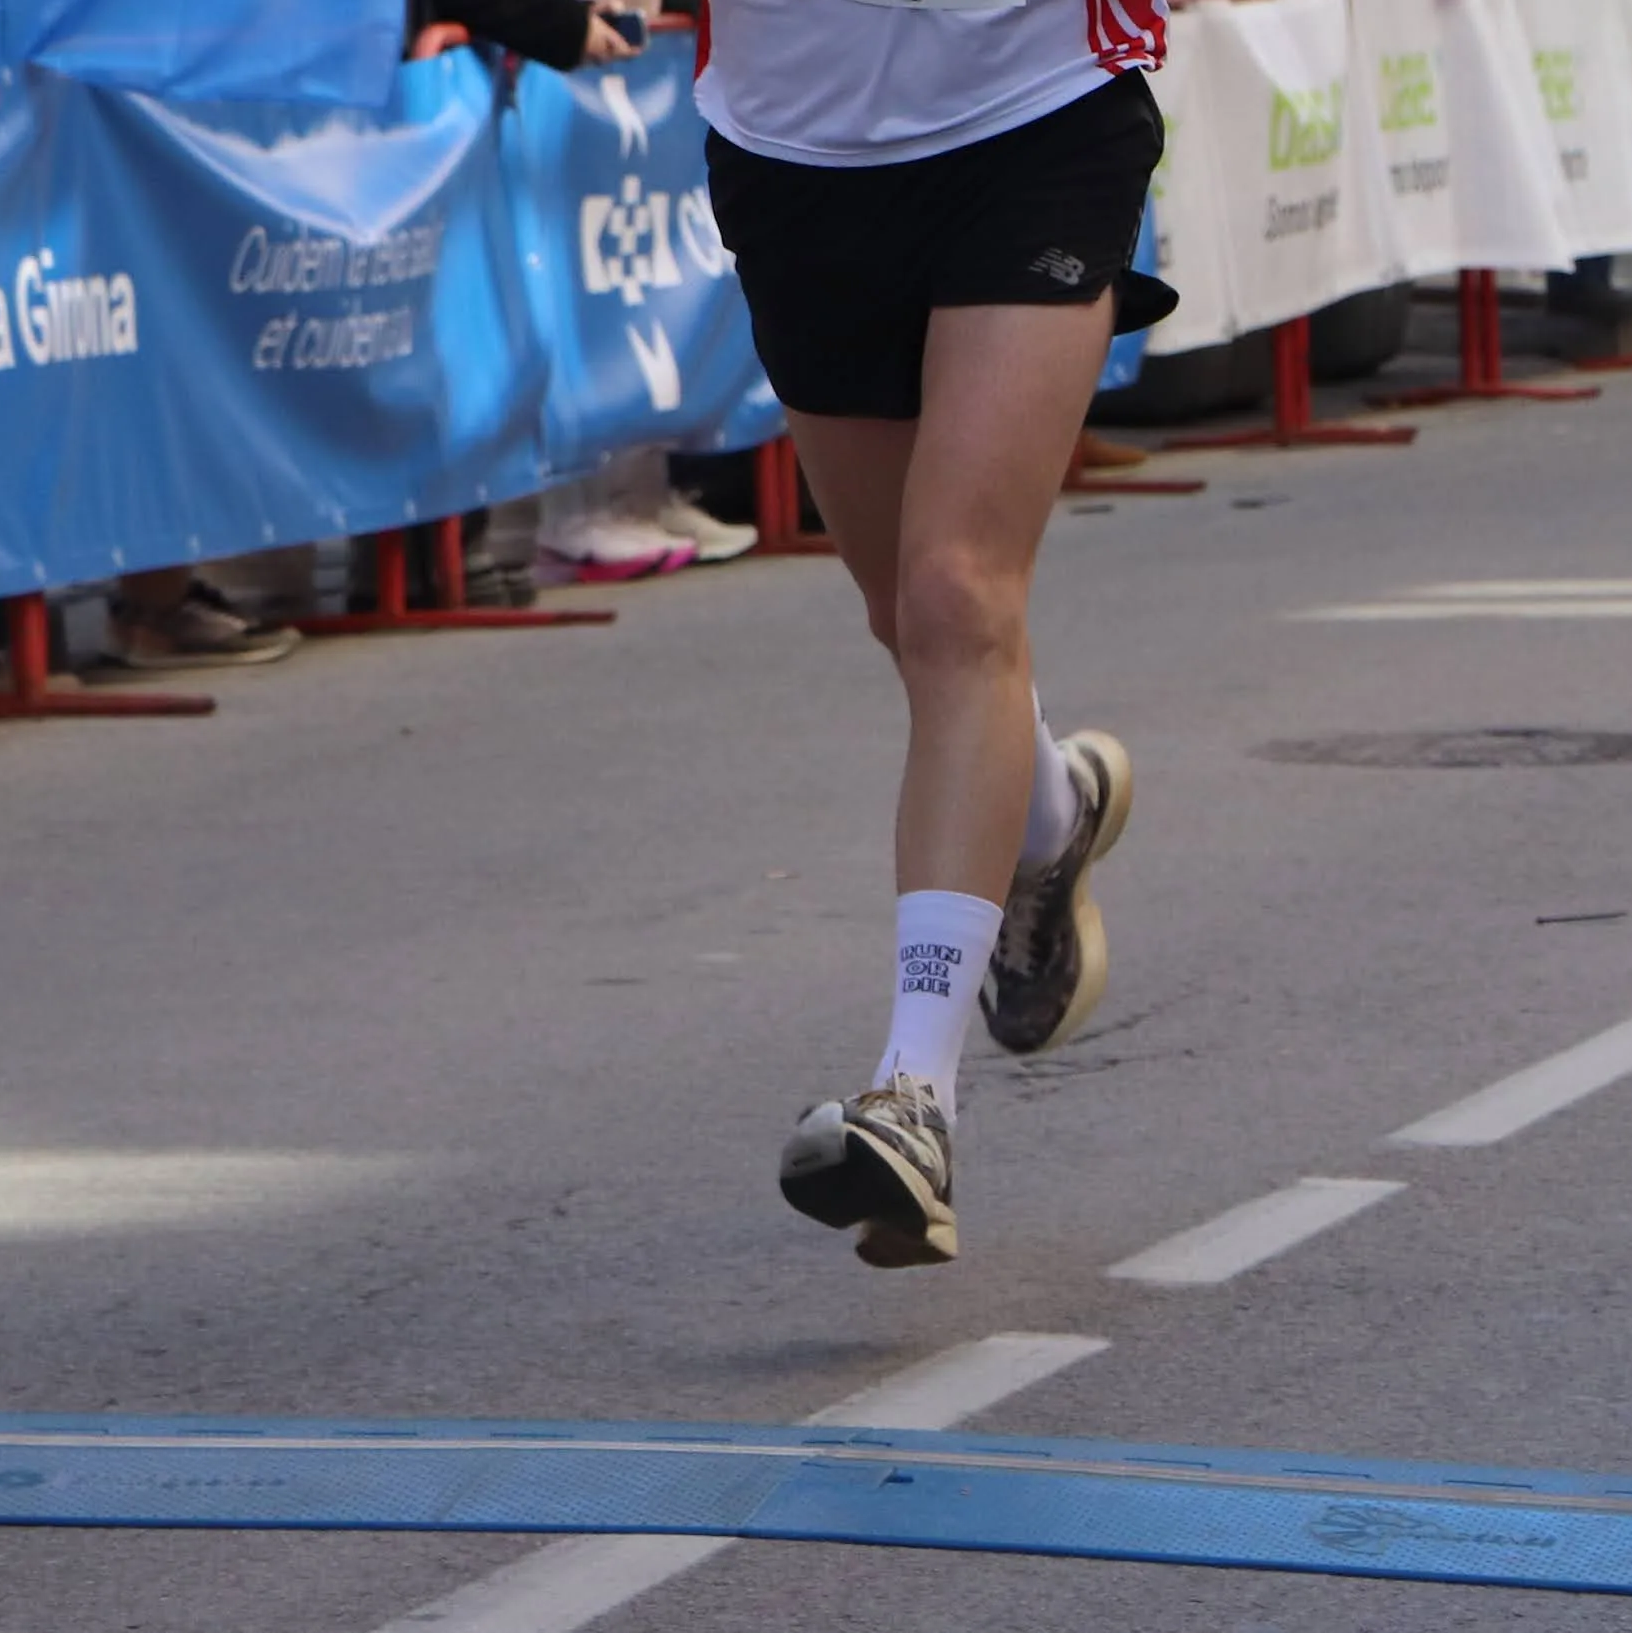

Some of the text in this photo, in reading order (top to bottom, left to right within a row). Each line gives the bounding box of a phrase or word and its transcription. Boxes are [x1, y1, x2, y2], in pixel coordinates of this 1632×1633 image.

[901, 943, 962, 965] RUN
[906, 960, 949, 978] OR
[903, 977, 950, 997] DIE
